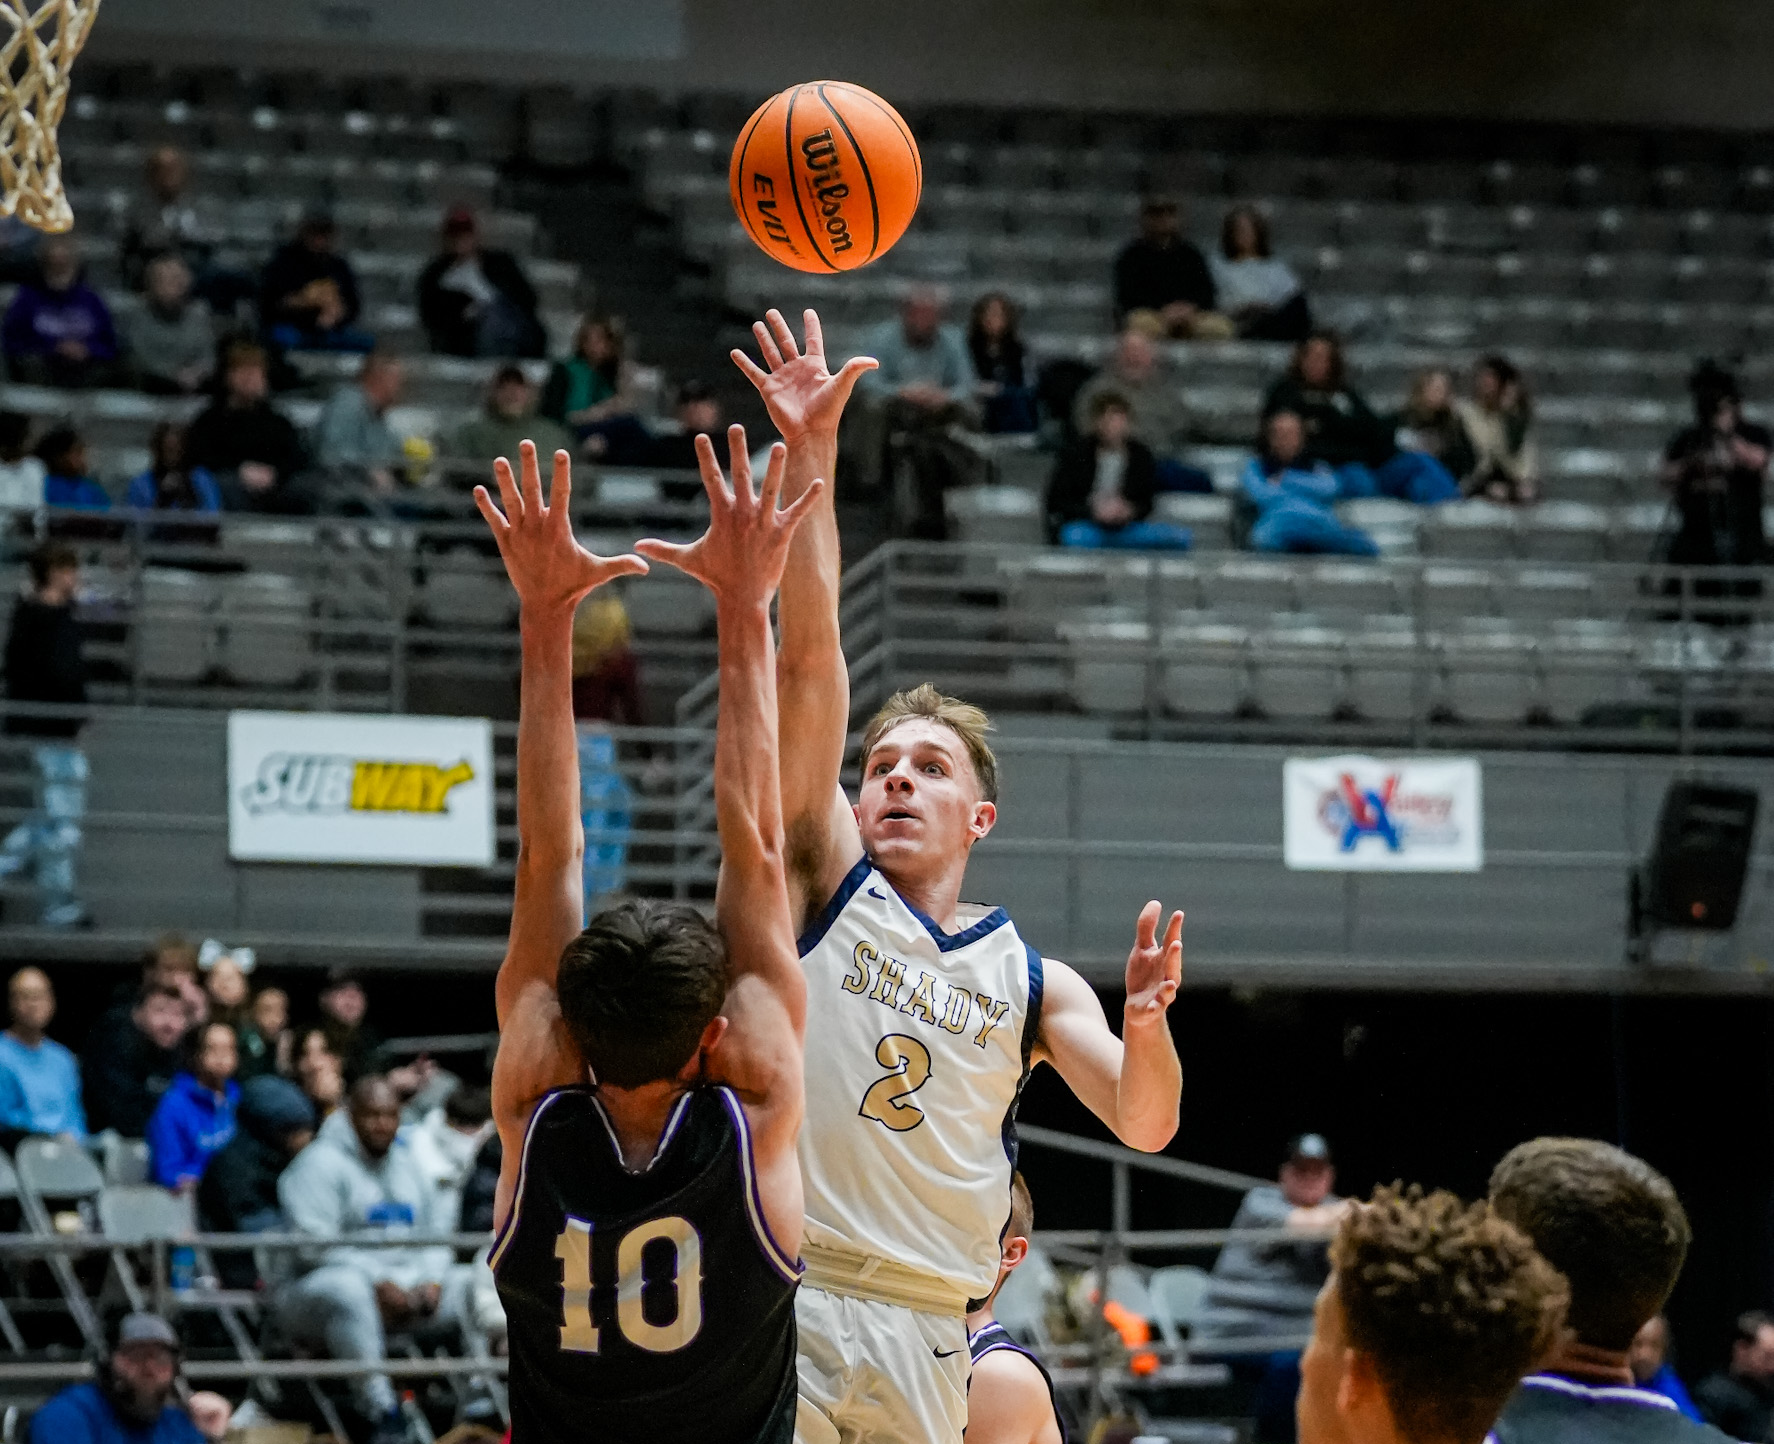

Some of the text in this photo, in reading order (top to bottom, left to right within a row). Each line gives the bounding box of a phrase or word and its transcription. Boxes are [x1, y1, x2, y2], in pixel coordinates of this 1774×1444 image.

[801, 127, 854, 254] Wilson
[240, 752, 474, 815] SUBWAY
[841, 940, 1010, 1049] SHADY
[858, 1032, 933, 1132] 2
[554, 1213, 705, 1355] 10
